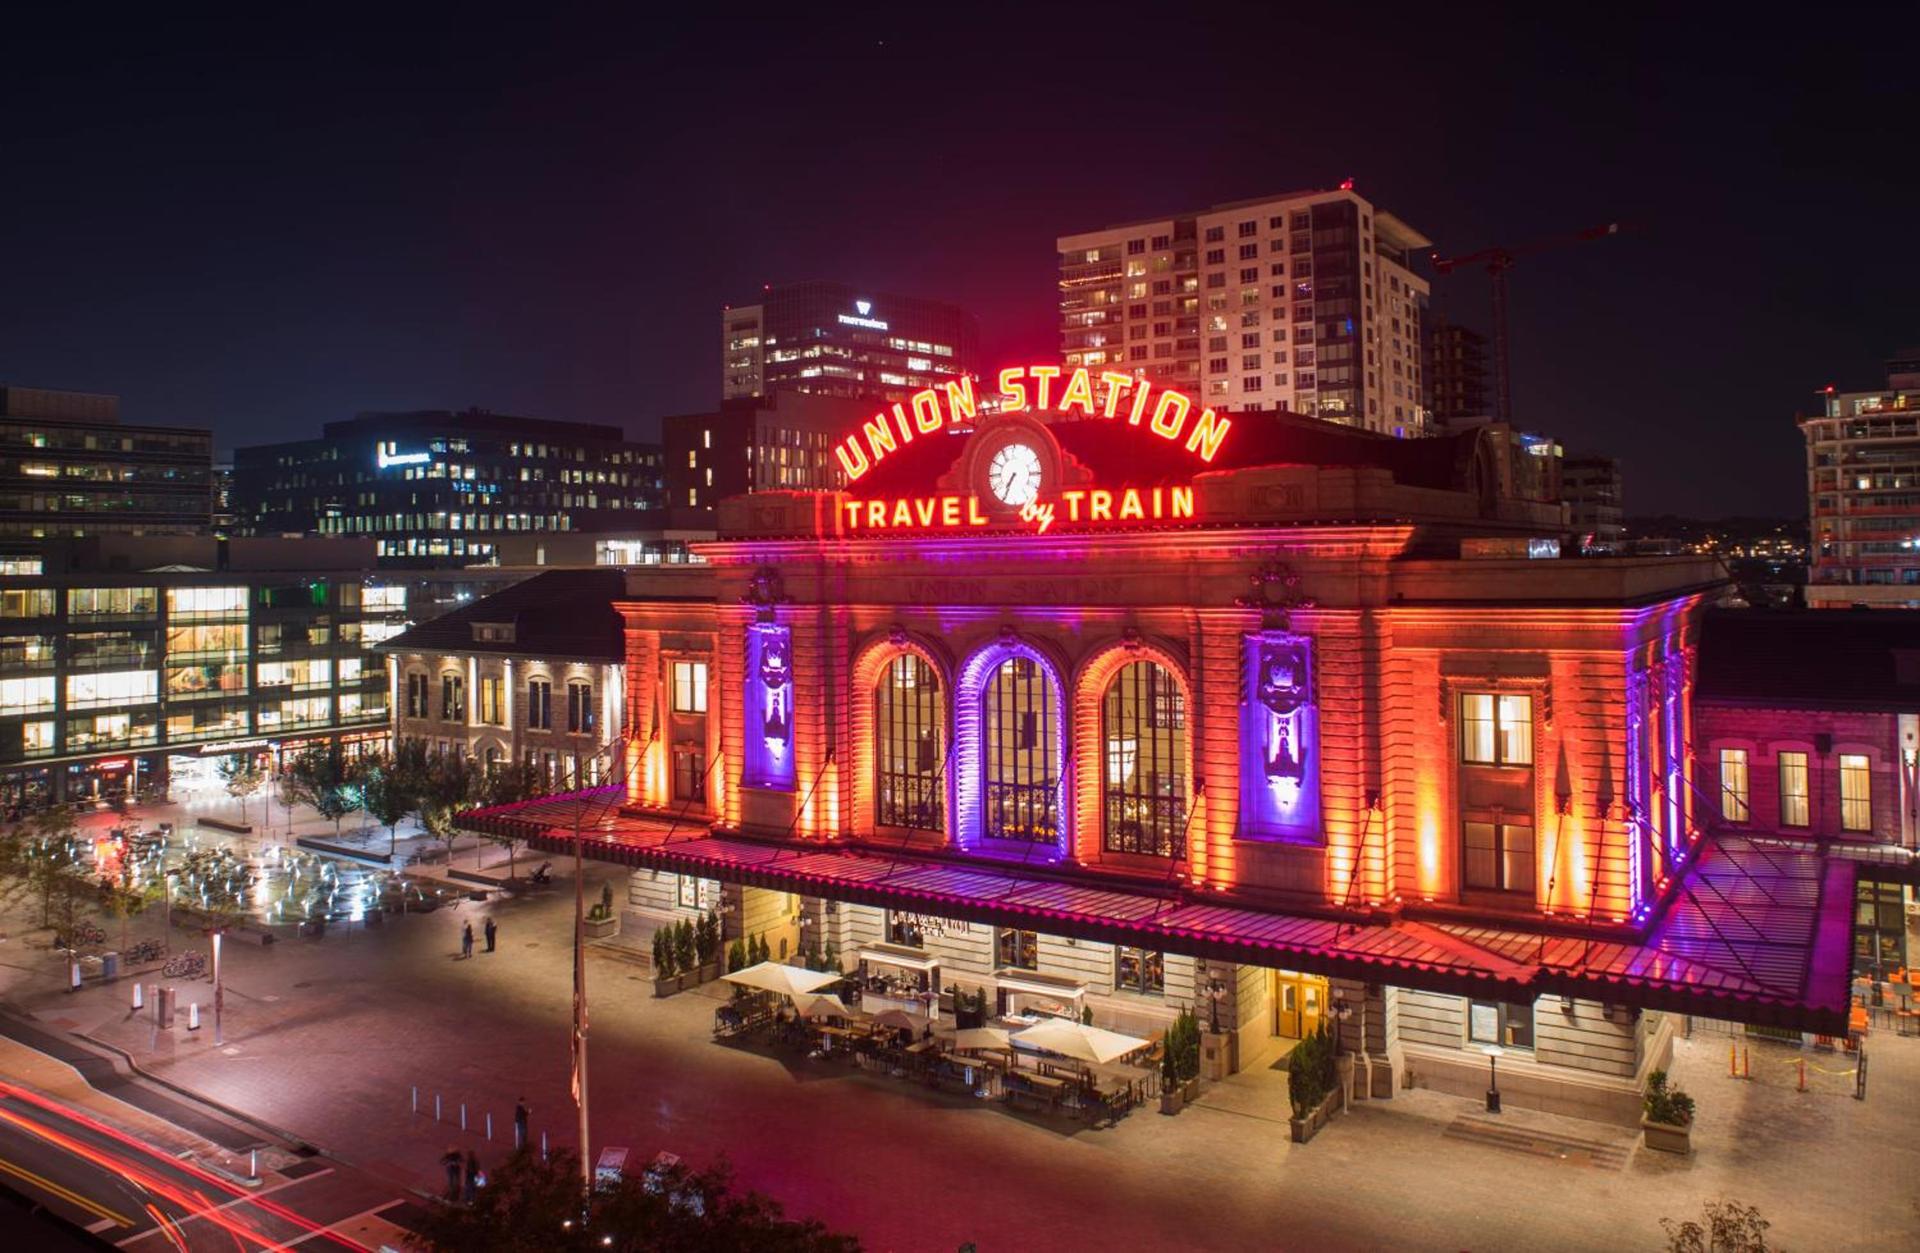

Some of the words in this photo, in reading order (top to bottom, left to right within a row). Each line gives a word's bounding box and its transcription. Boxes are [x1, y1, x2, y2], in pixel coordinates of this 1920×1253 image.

[835, 376, 978, 480] UNION
[999, 365, 1232, 463] STATION
[844, 495, 989, 529] TRAVEL
[1018, 494, 1056, 534] by
[1062, 486, 1195, 522] TRAIN
